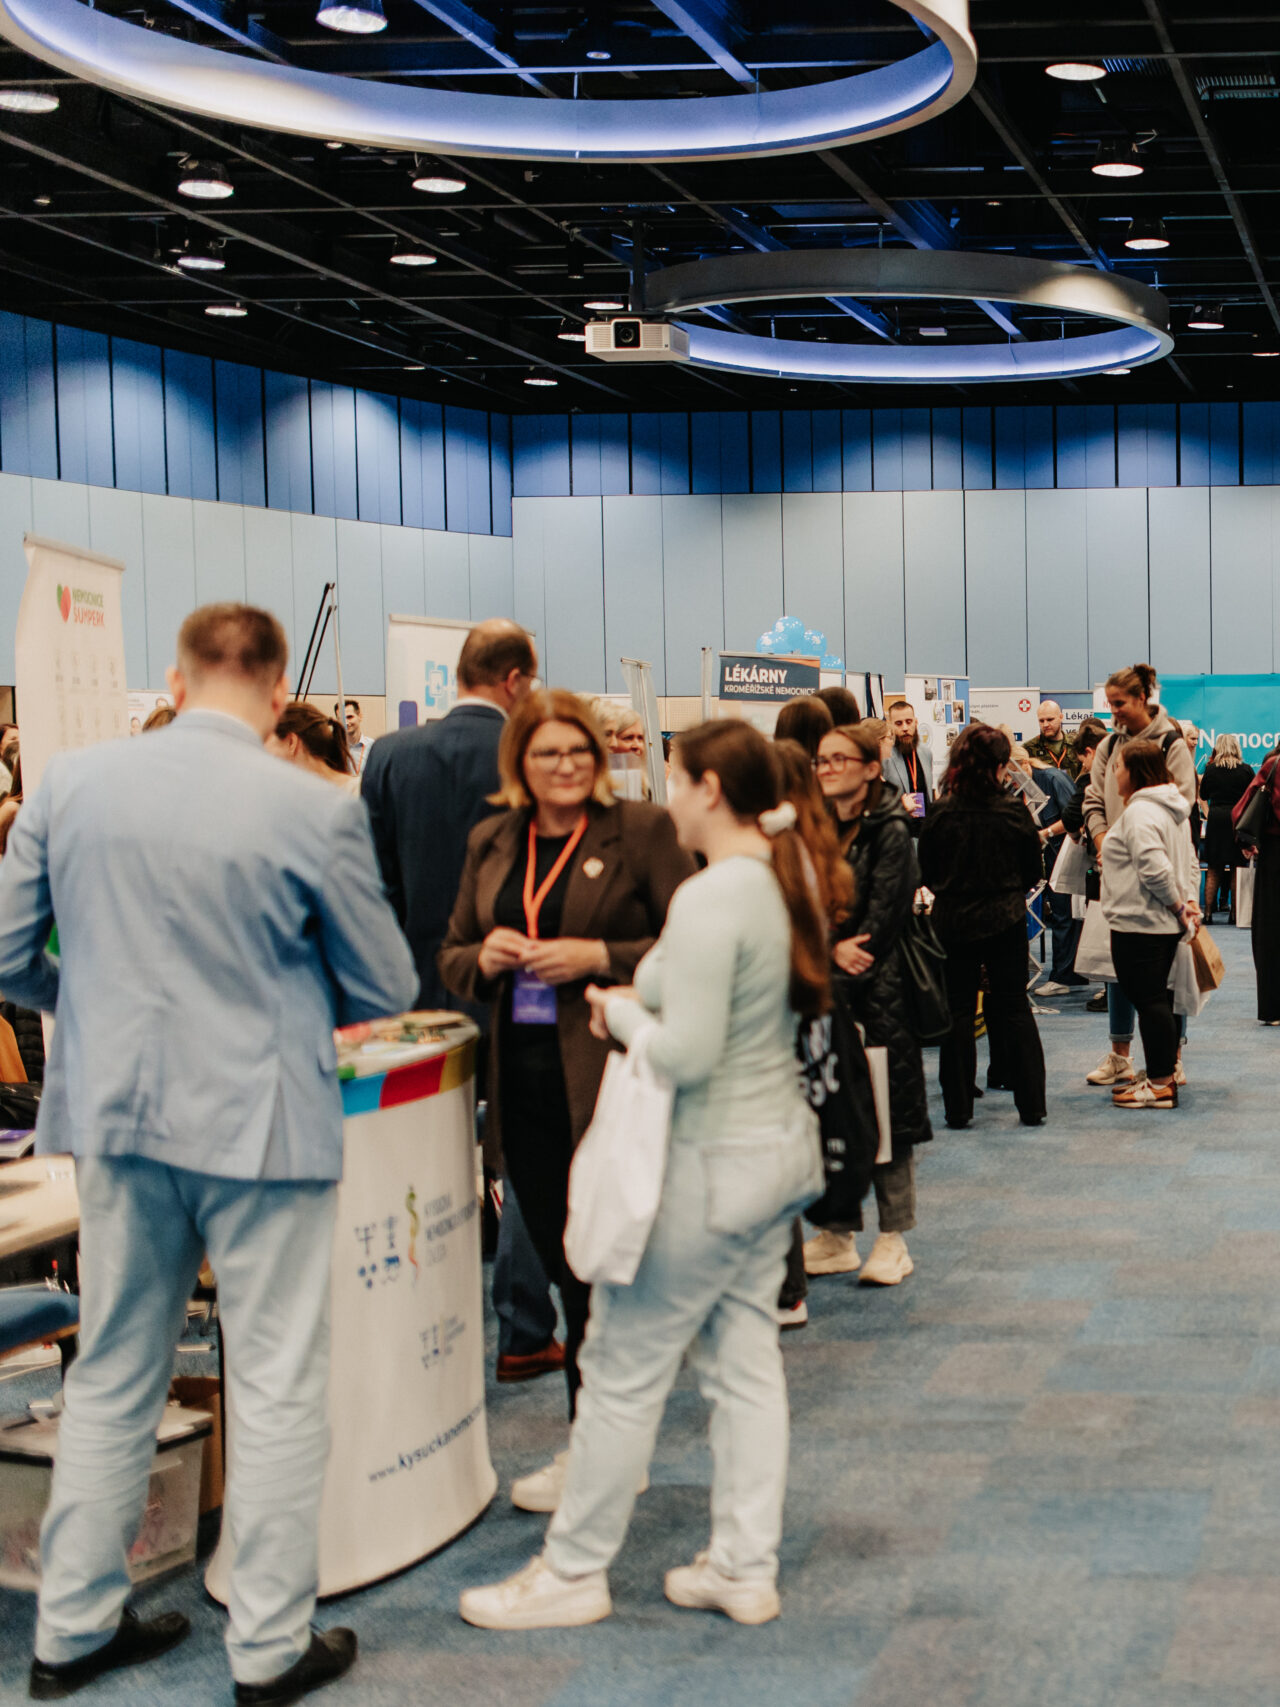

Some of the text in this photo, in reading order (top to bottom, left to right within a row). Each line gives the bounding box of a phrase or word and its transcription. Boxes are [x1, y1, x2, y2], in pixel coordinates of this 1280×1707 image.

[725, 663, 788, 684] LÉKÁRNY
[724, 683, 815, 696] KROMĚŘÍŽSKÉ NEMOCNICE
